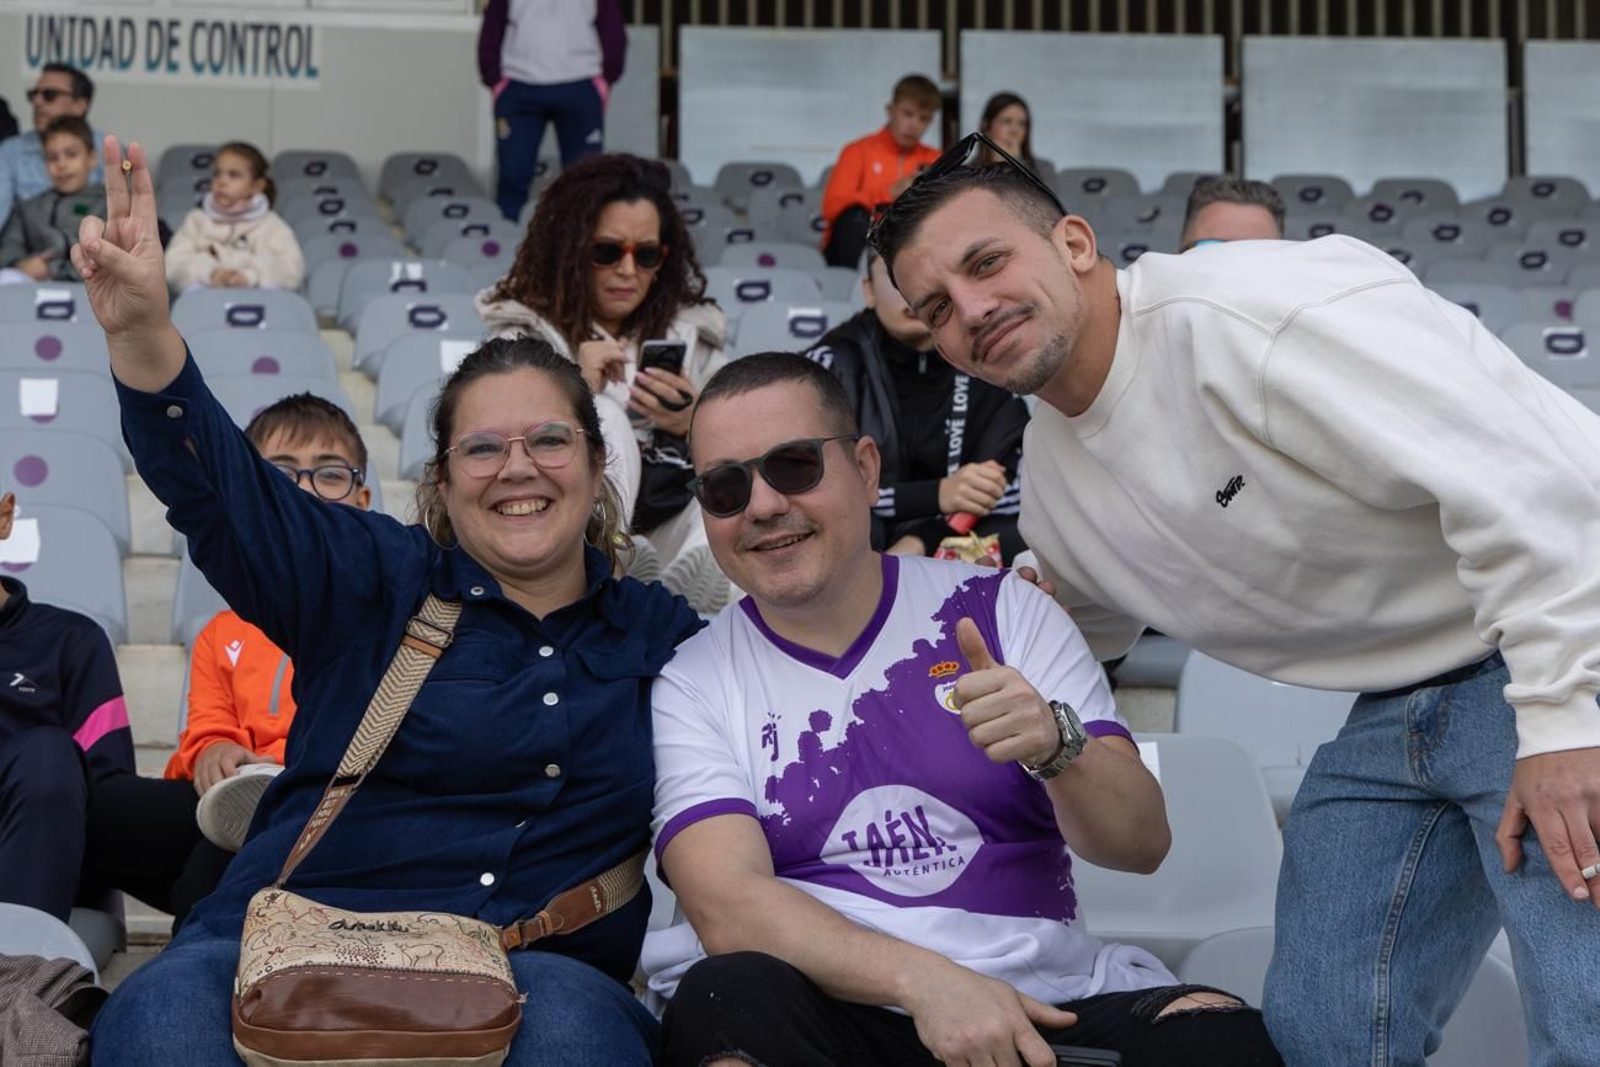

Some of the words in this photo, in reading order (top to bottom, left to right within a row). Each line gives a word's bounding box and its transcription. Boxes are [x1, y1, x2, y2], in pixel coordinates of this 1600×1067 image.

[25, 14, 137, 71] UNIDAD
[145, 18, 181, 73] DE
[190, 20, 319, 78] CONTROL
[952, 374, 971, 412] LOVE
[884, 855, 966, 877] AUTÉNTICA
